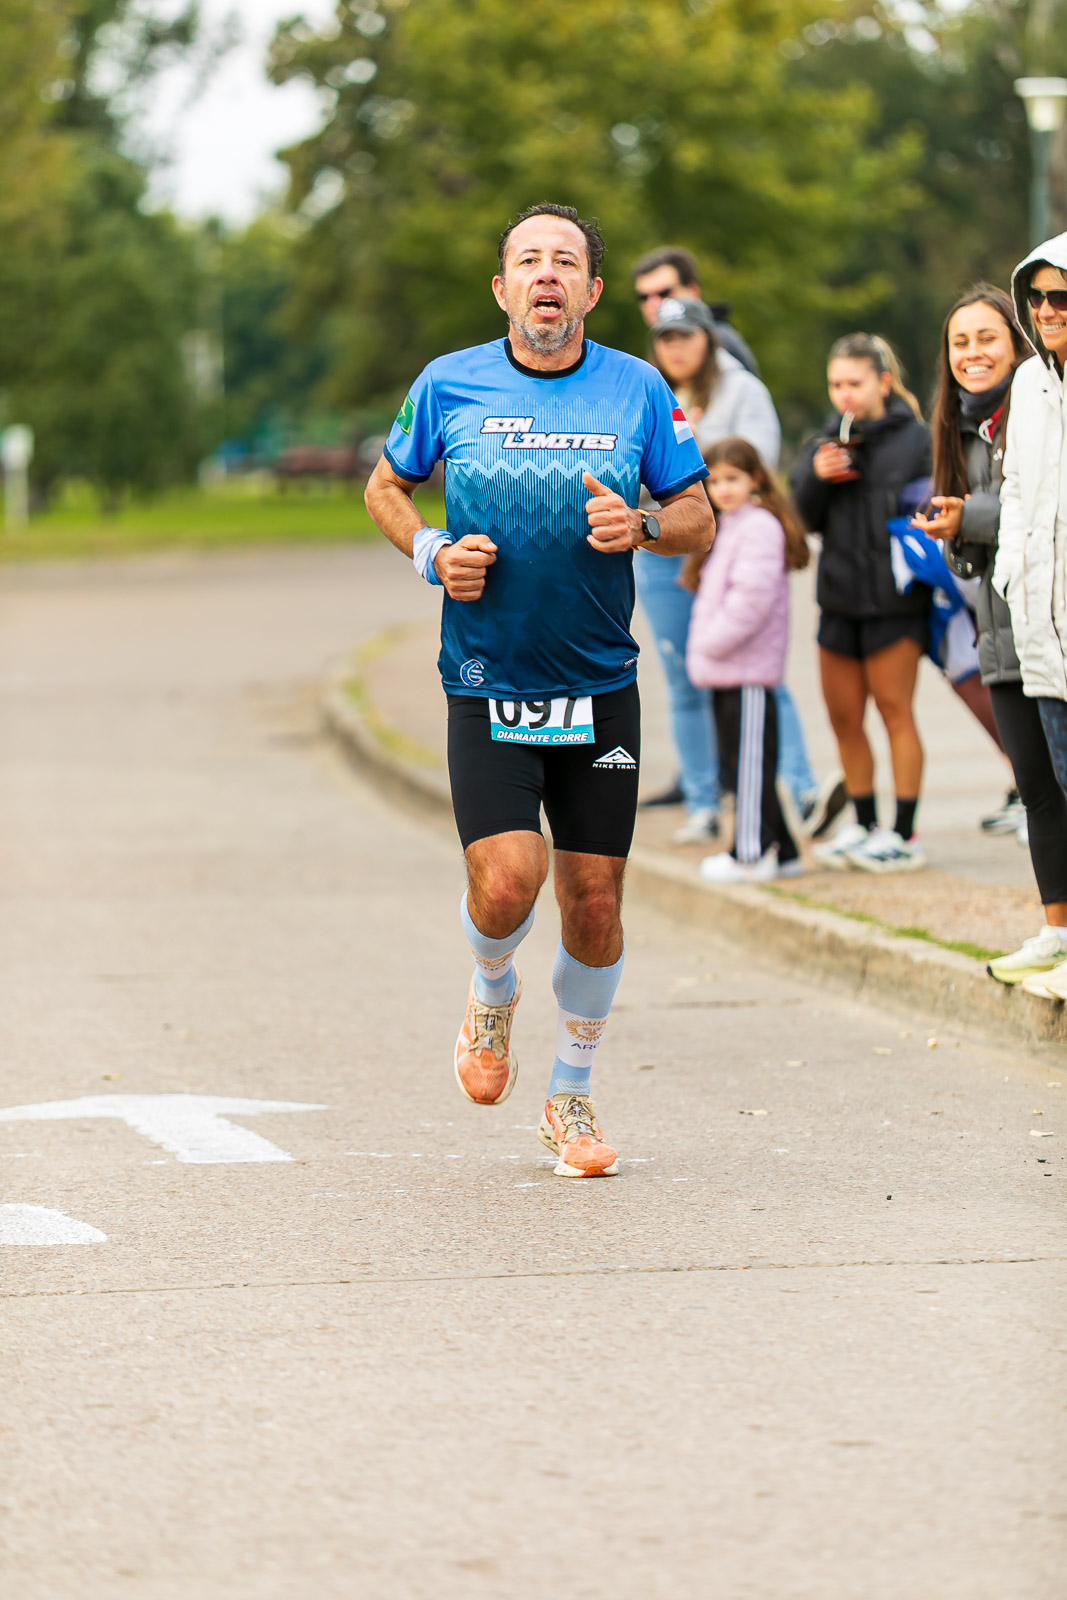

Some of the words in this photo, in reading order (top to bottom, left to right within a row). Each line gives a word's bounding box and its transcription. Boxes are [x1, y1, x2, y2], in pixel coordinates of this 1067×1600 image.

[480, 416, 535, 434] SIN
[501, 432, 618, 451] LIMITES
[496, 730, 550, 743] DIAMANTE
[552, 732, 588, 743] CORRE
